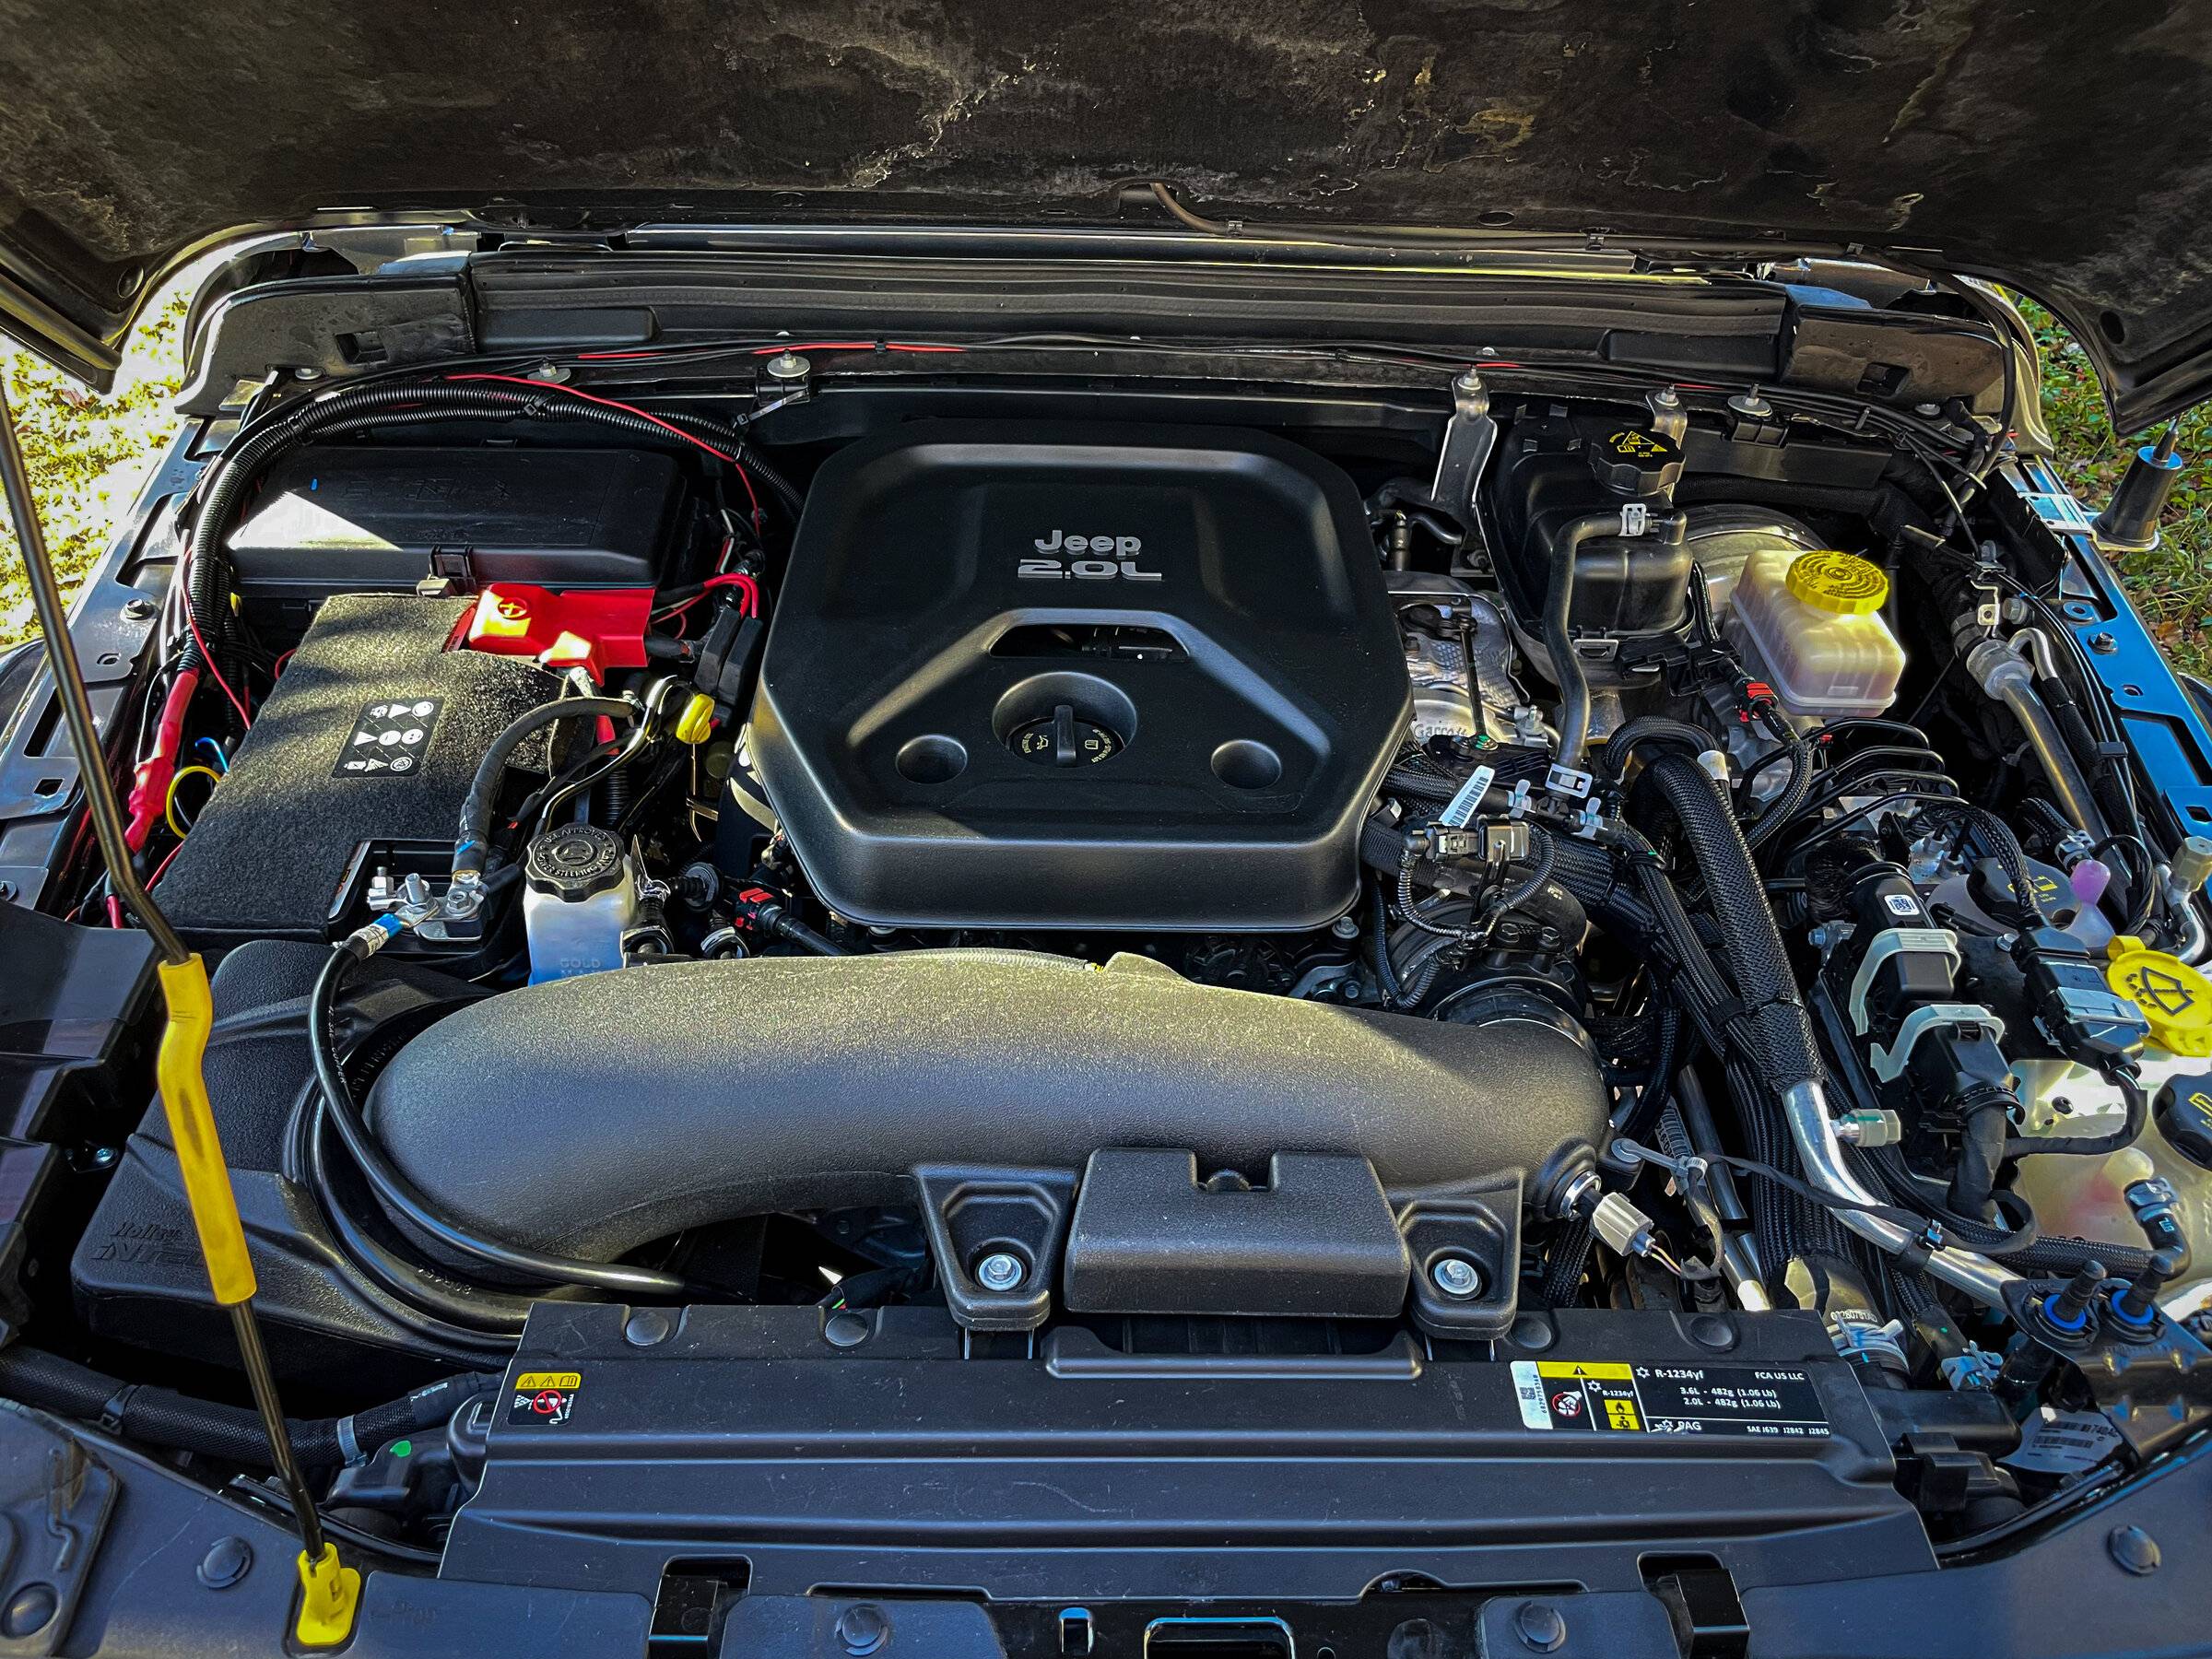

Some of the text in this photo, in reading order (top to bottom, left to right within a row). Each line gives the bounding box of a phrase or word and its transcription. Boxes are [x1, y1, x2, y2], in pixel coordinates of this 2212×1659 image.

[1034, 530, 1142, 559] Jeep
[1018, 559, 1162, 582] 2.0L
[1654, 1369, 1704, 1381] R-1234yf
[1754, 1371, 1773, 1380] FCA
[1788, 1372, 1806, 1381] LLC
[1680, 1386, 1700, 1395] 3.6L
[1712, 1388, 1735, 1397] 482g
[1736, 1388, 1760, 1398] (1.06
[1683, 1397, 1704, 1406] 2.0L
[1715, 1398, 1738, 1408] 482g
[1740, 1398, 1764, 1408] (1.06
